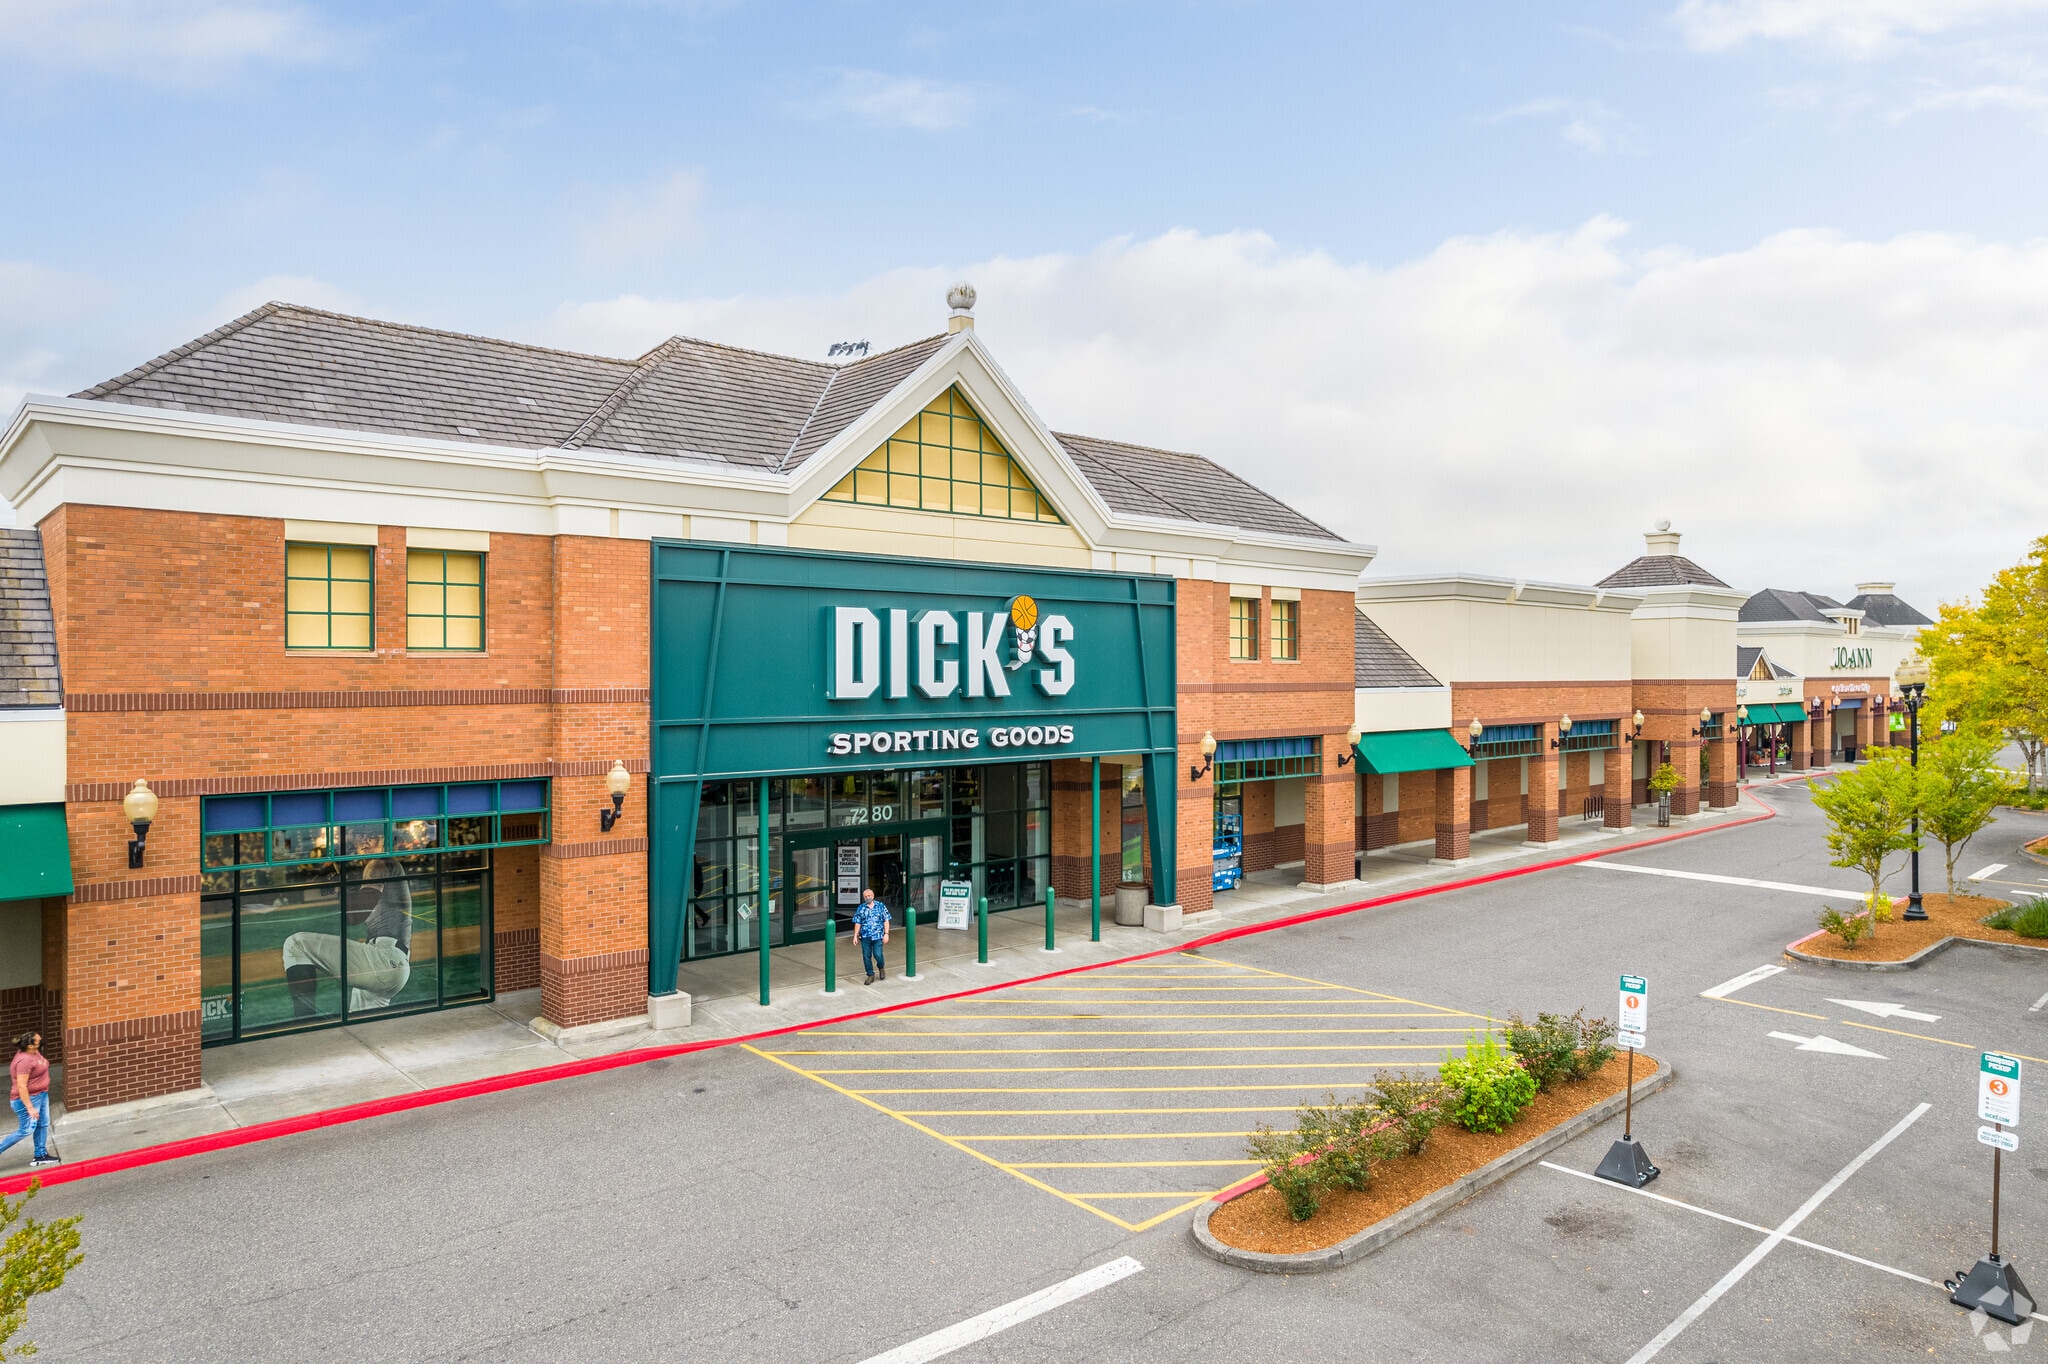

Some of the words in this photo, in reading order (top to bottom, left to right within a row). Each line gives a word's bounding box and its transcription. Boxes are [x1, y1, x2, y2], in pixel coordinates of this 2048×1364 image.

[827, 594, 1075, 700] DICK'S
[828, 728, 980, 755] SPORTING
[988, 725, 1074, 748] GOODS
[850, 805, 893, 824] 7280
[1629, 997, 1635, 1008] 1
[1988, 1062, 2012, 1073] PICKUP
[1993, 1081, 2004, 1095] 3
